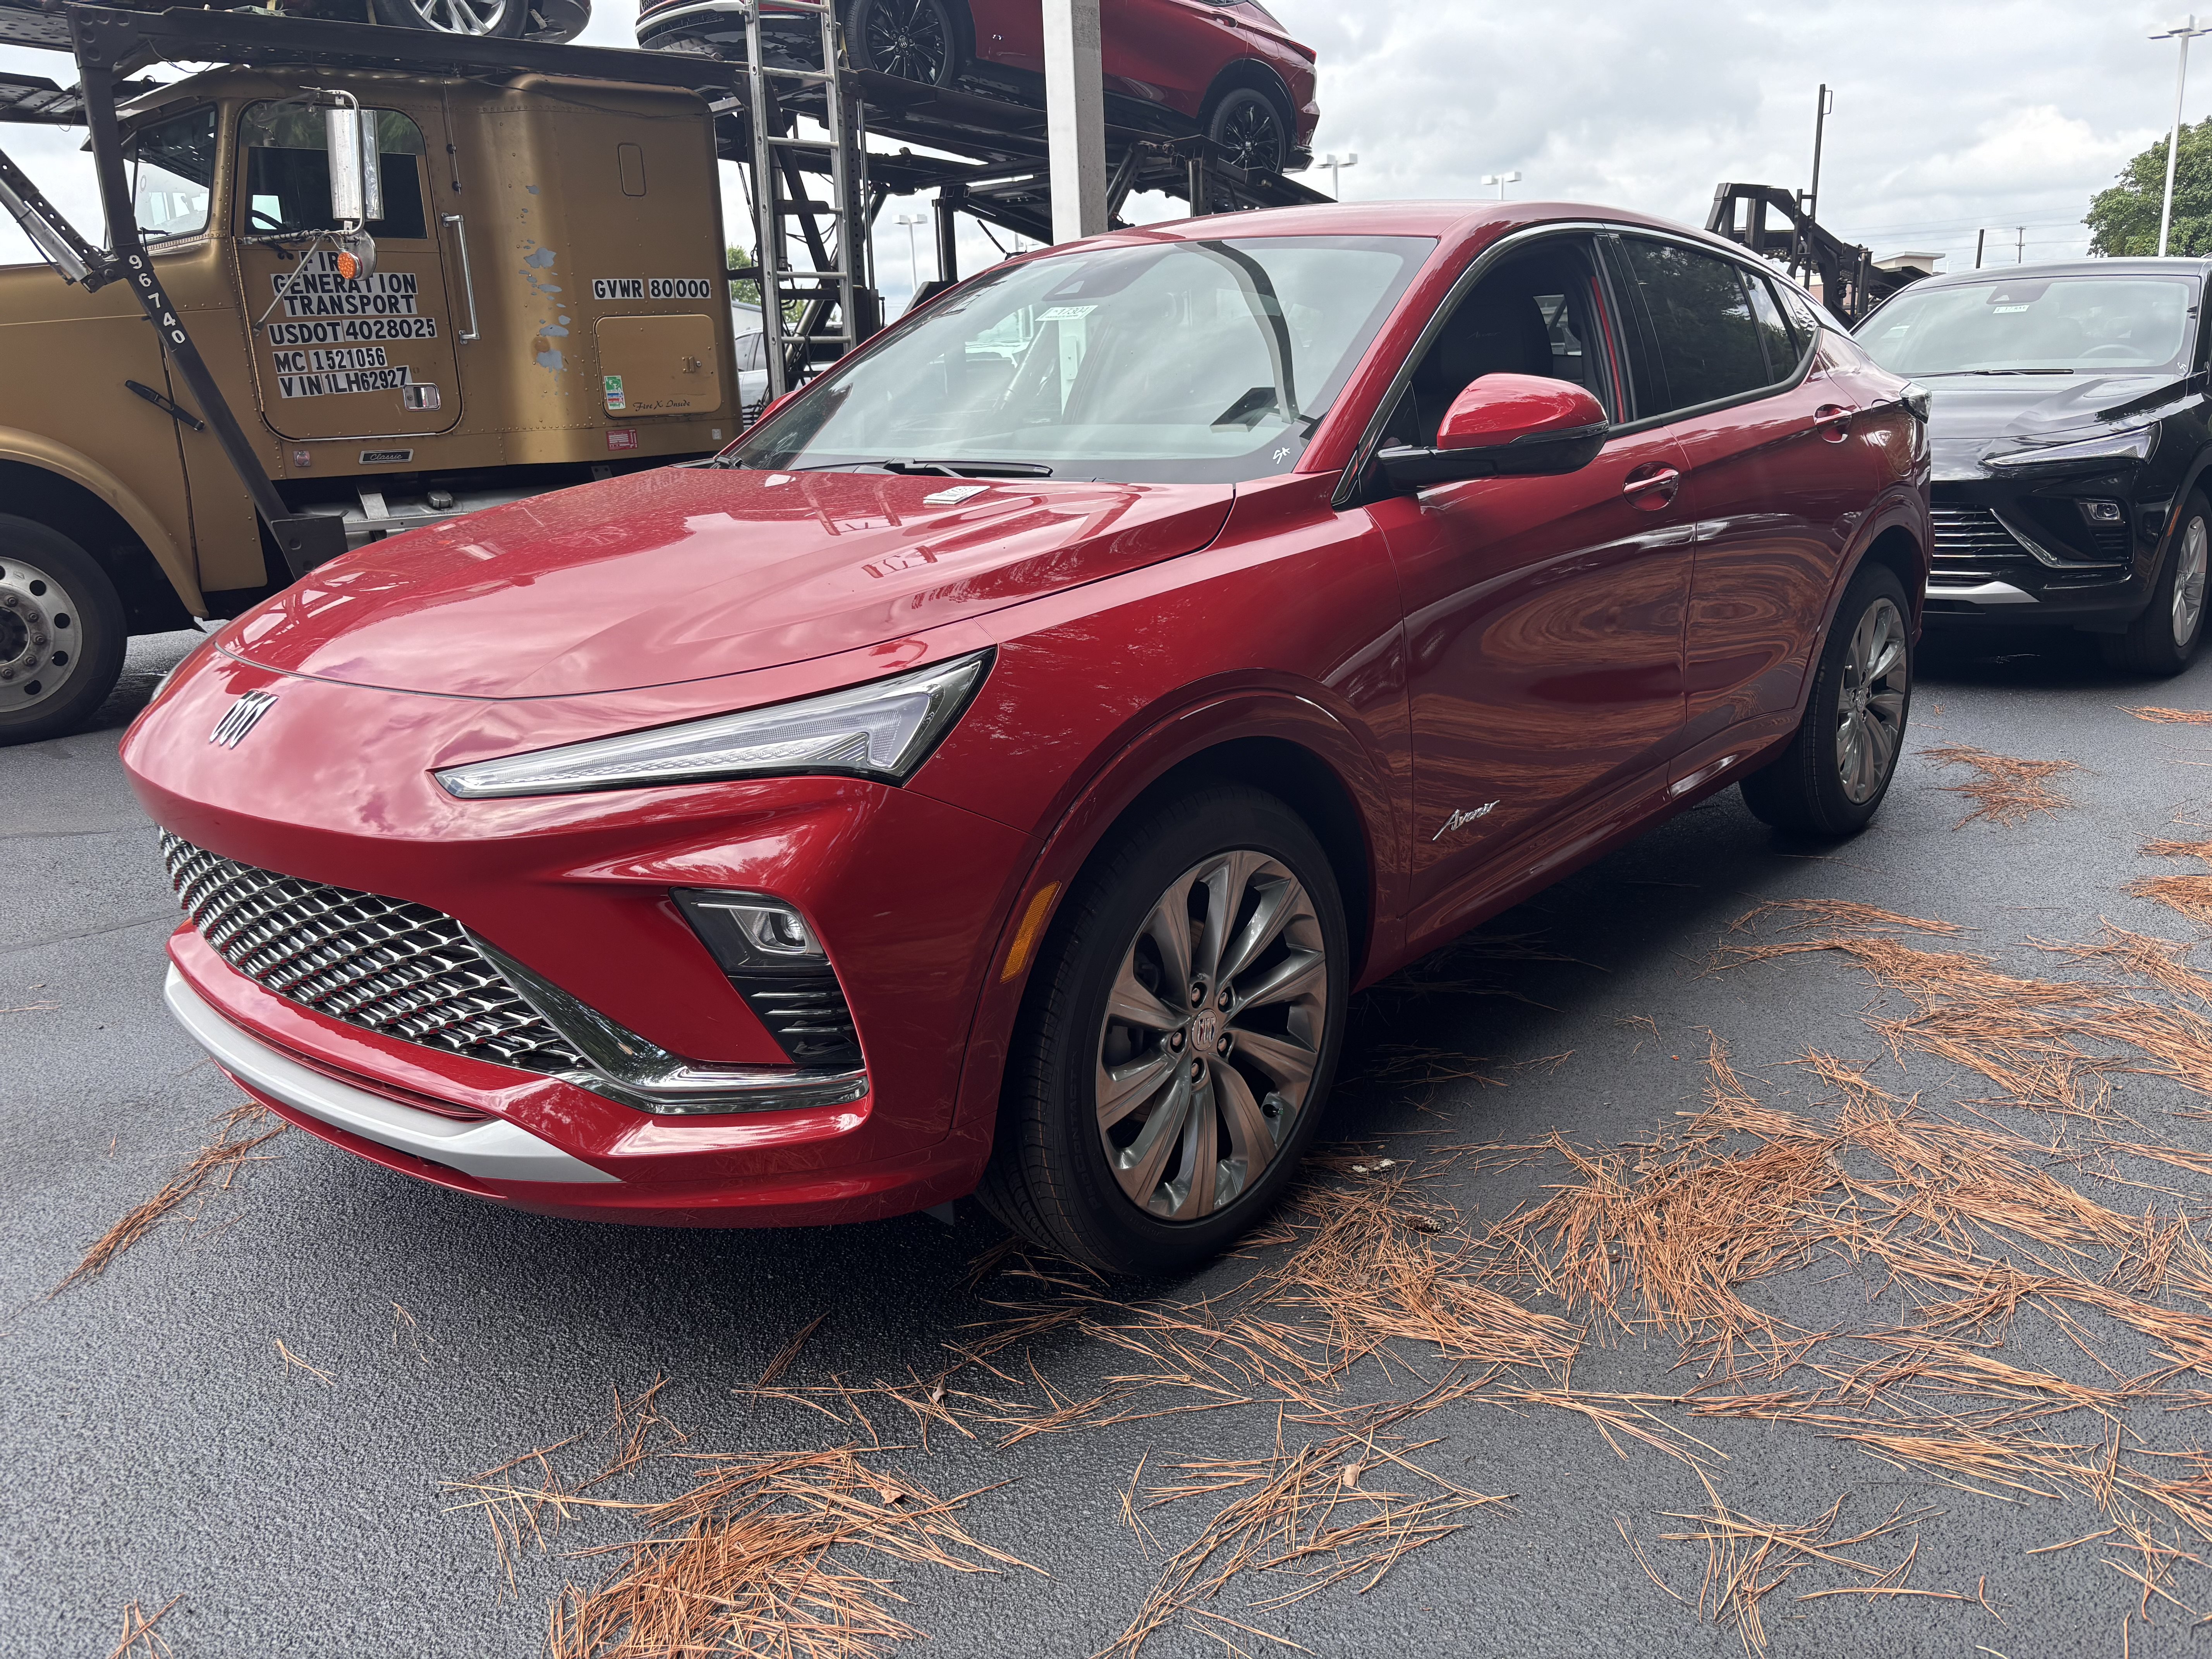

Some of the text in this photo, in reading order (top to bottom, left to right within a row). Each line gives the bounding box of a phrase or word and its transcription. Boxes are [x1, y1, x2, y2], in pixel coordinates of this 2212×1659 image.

[273, 273, 417, 294] GENERATION
[594, 280, 709, 298] GVWR 80000
[284, 294, 414, 315] TRANSPORT
[271, 318, 436, 345] USDOT 4028025
[274, 347, 386, 373] MC 1521056
[279, 366, 408, 397] VIN 1LH62927
